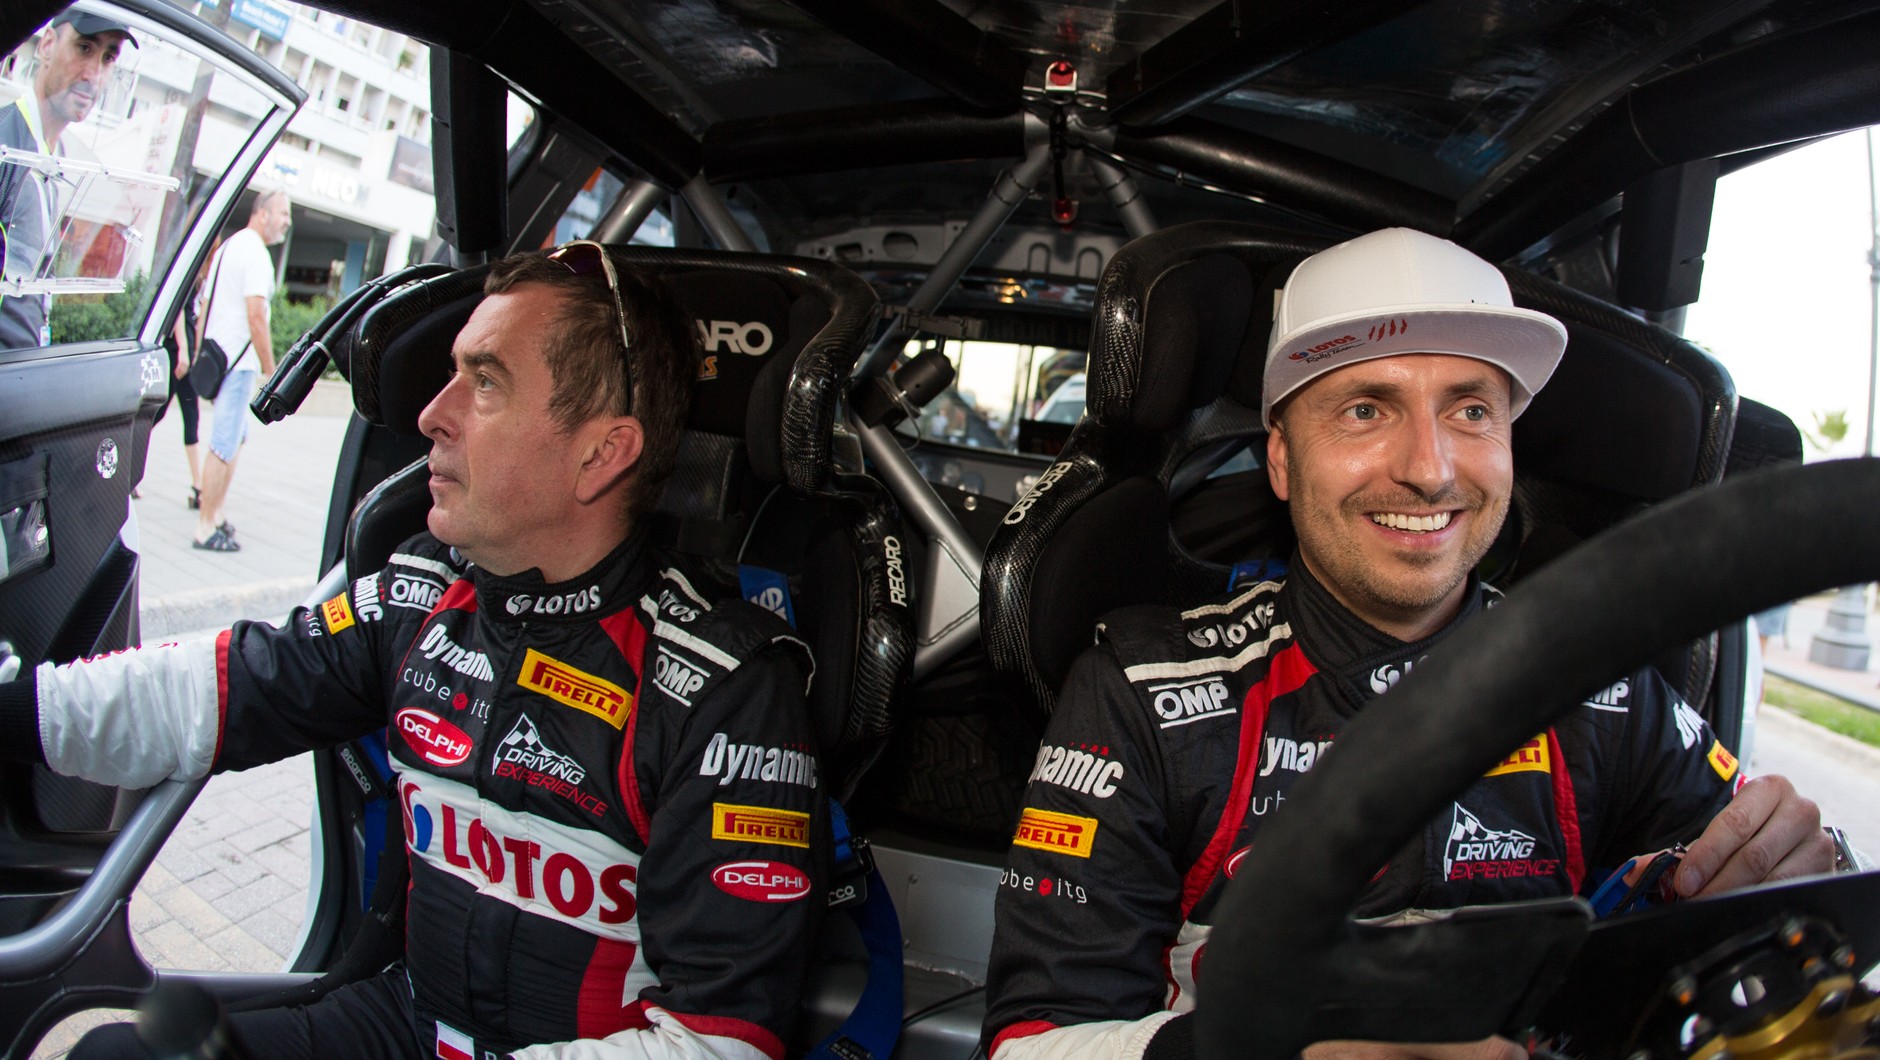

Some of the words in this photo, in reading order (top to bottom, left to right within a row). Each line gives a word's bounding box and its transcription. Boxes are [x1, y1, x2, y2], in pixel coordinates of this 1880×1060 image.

[1306, 351, 1332, 364] Rally
[1307, 335, 1356, 354] LOTOS
[1004, 462, 1073, 525] RECARO
[884, 536, 907, 607] RECARO
[390, 578, 443, 608] OMP
[533, 584, 600, 615] LOTOS
[403, 667, 451, 701] cube
[529, 660, 625, 717] PIRELLI
[655, 653, 705, 698] OMP
[1154, 681, 1229, 720] OMP
[403, 716, 466, 757] DELPHI
[504, 747, 586, 785] DRIVING
[496, 762, 608, 817] EXPERIENCE
[724, 811, 805, 841] PIRELLI
[441, 803, 637, 924] LOTOS
[1455, 842, 1535, 861] DRIVING
[723, 871, 803, 889] DELPHI
[1449, 860, 1560, 880] EXPERIENCE
